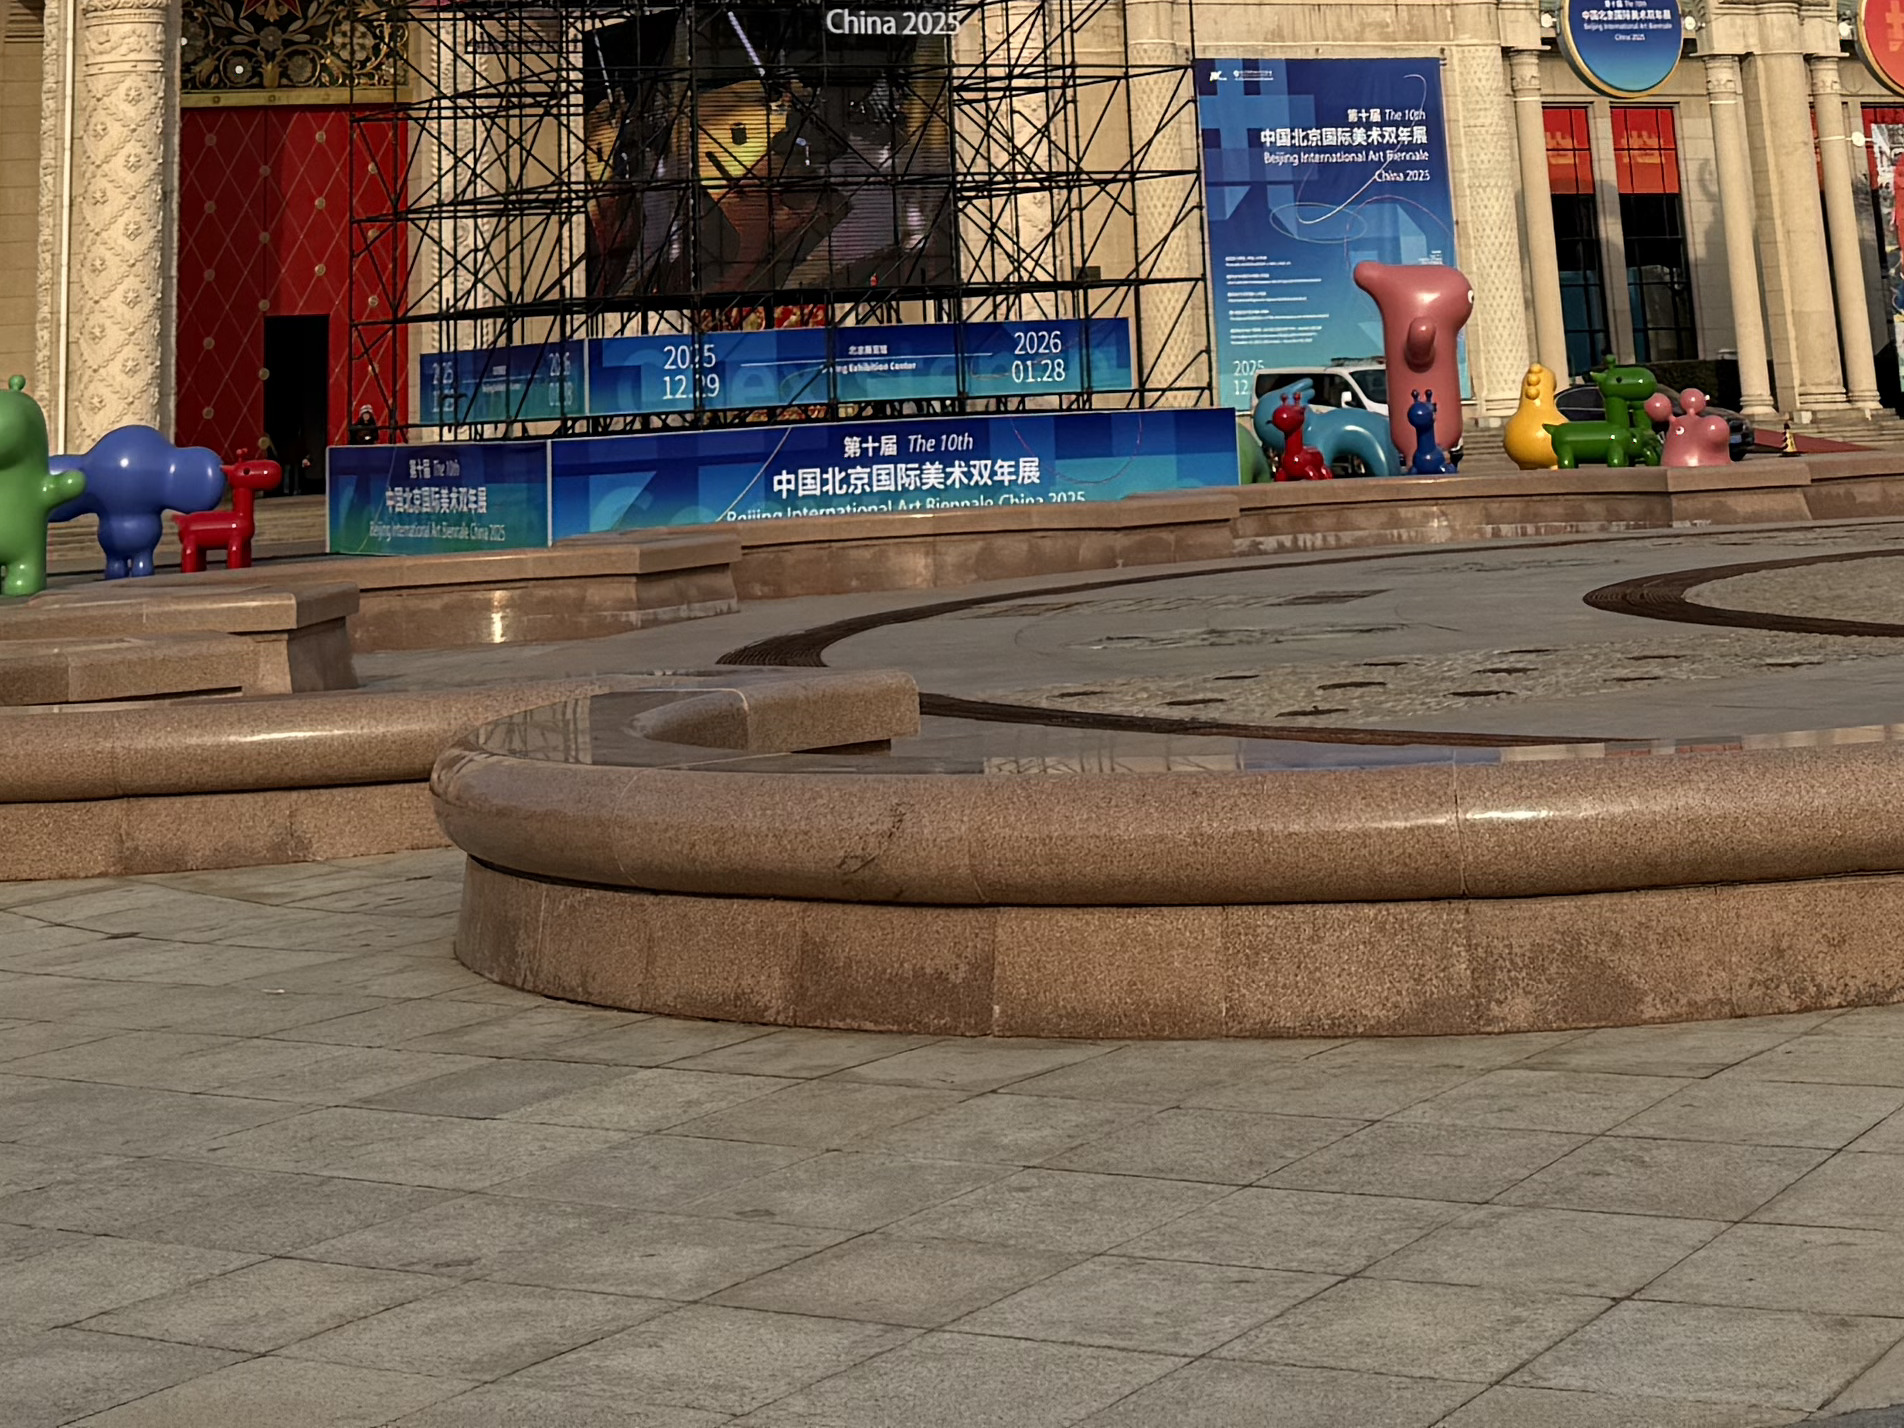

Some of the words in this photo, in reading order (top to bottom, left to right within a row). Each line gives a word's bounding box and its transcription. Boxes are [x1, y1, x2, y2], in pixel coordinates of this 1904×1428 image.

[827, 9, 896, 35] China
[901, 10, 961, 36] 2025
[1260, 125, 1428, 148] 中国北京国际美术双年展
[1013, 330, 1063, 356] 2026
[1011, 358, 1066, 384] 01.28
[843, 435, 897, 459] 第十届
[907, 434, 936, 452] The
[940, 433, 973, 451] 10th
[772, 457, 1041, 500] 中国北京国际美术双年展
